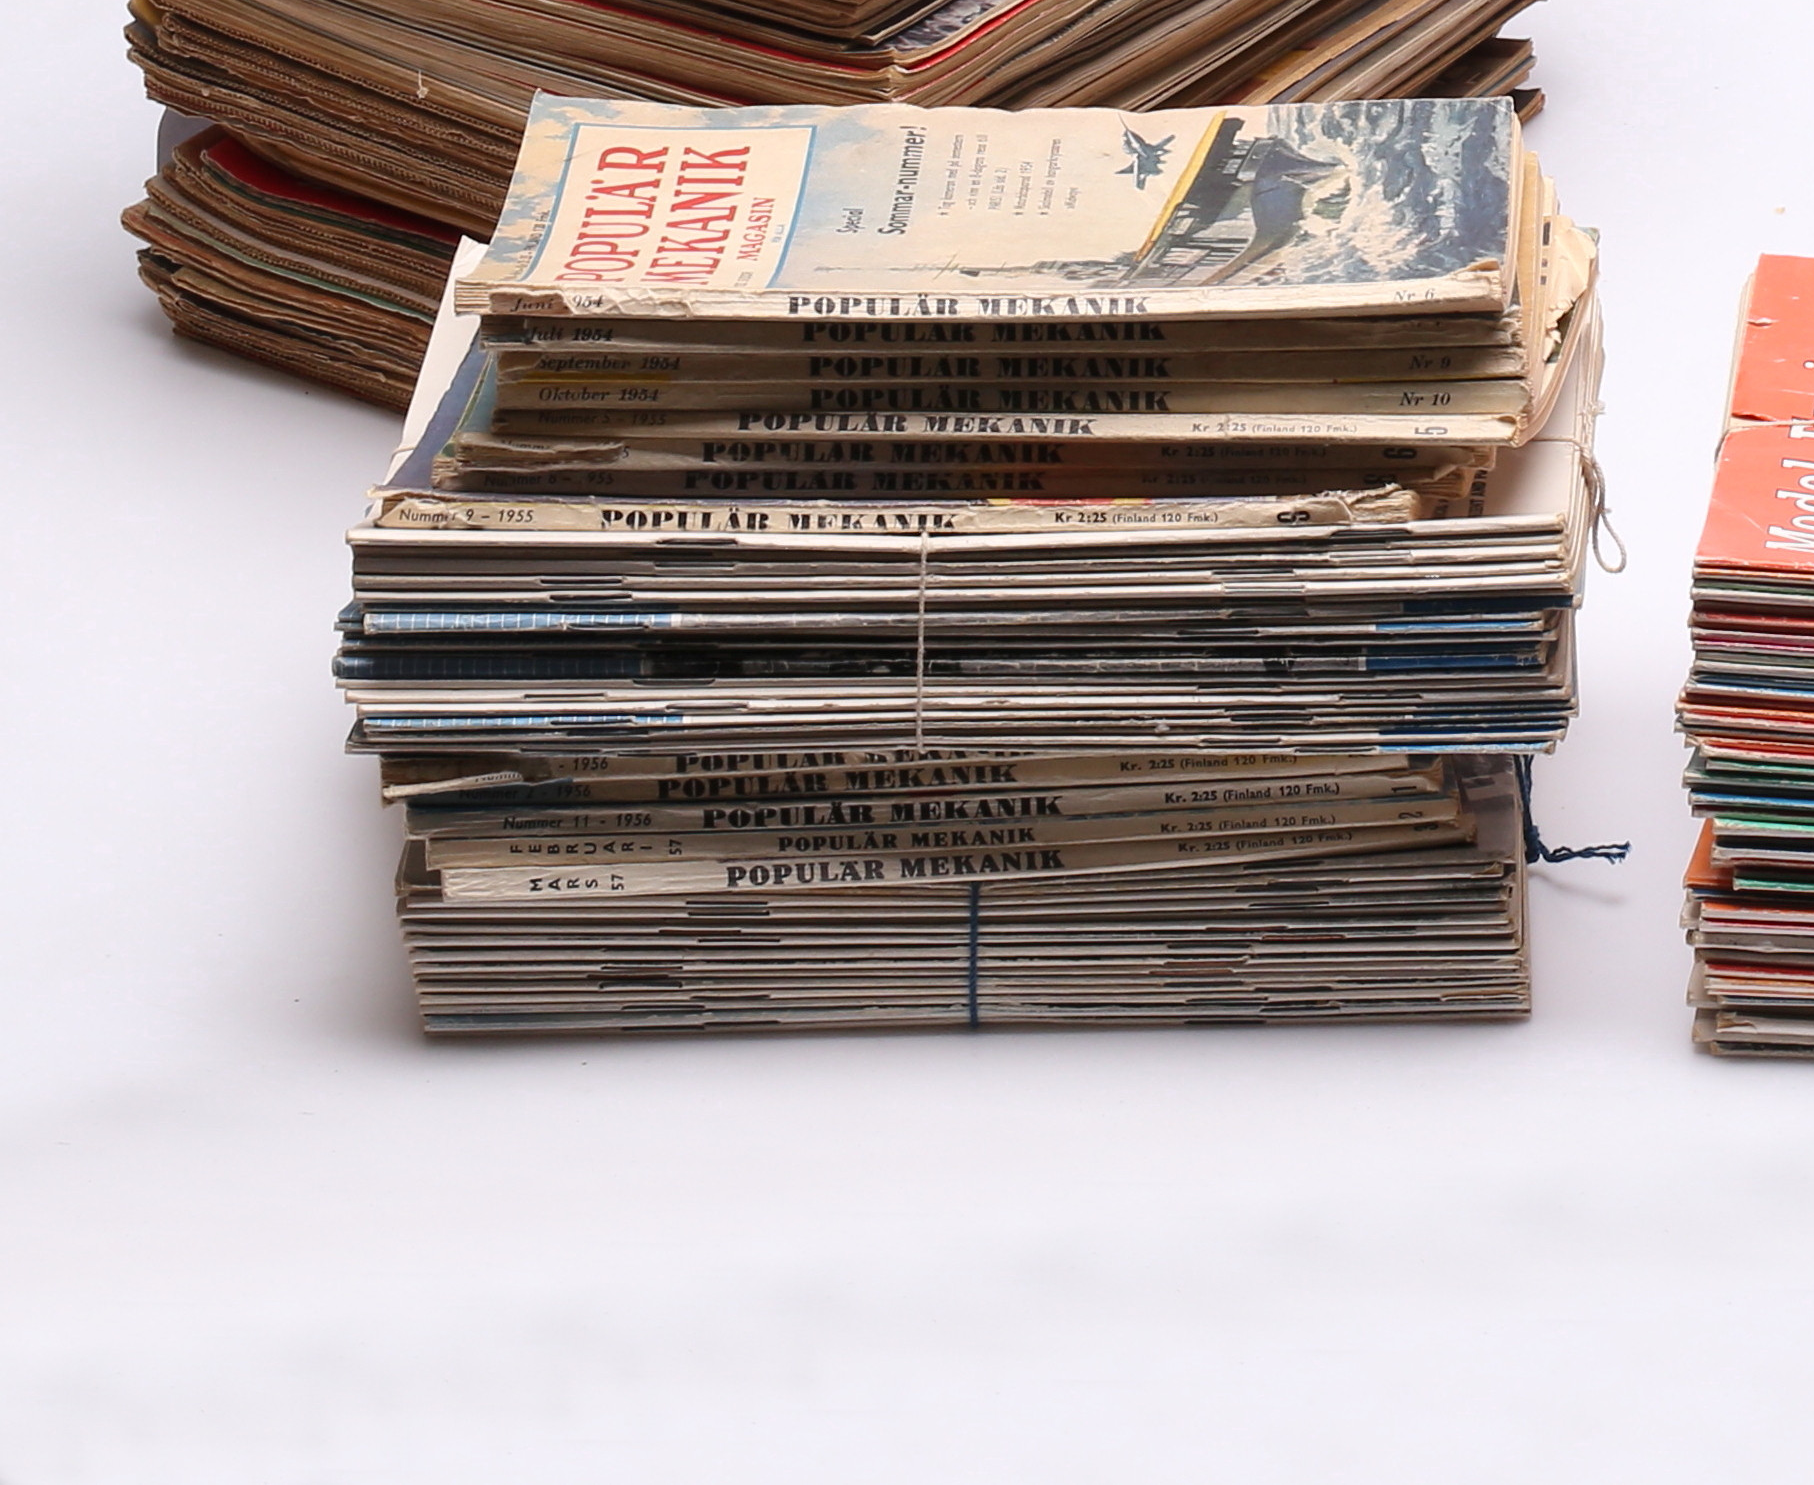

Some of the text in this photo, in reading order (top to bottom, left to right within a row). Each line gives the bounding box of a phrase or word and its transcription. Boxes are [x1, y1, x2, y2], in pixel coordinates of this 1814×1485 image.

[877, 125, 927, 235] Sommar-nummer!
[554, 146, 670, 282] POPULÄR
[640, 145, 751, 285] MEKANIK
[836, 207, 865, 233] Special
[736, 197, 776, 261] MAGASIN
[509, 297, 554, 313] Juni
[564, 294, 604, 310] 954
[788, 294, 960, 316] POPULÄR
[976, 297, 1151, 316] MEKANIK
[573, 327, 614, 343] 1954
[991, 323, 1168, 342] MEKANIK
[640, 357, 681, 370] 1954
[808, 355, 981, 378] POPULÄR
[997, 358, 1172, 378] MEKANIK
[1408, 356, 1433, 370] Nr
[538, 386, 1451, 411] Oktober 1954 POPULÄR MEKANIK Nr 10
[737, 412, 907, 433] POPULÄR
[922, 416, 1099, 436] MEKANIK
[1192, 423, 1211, 433] Kr
[1217, 423, 1247, 433] 2:25
[1252, 424, 1295, 434] (Finland
[1300, 425, 1321, 433] 120
[1326, 424, 1358, 434] Fmk.)
[889, 443, 1066, 464] MEKANIK
[872, 471, 1047, 492] MEKANIK
[466, 510, 474, 522] 9
[498, 510, 534, 523] 1955
[600, 508, 769, 531] POPULÄR
[788, 514, 958, 531] MEKANIK
[1055, 512, 1071, 523] Kr
[1077, 512, 1107, 524] 2:25
[1112, 513, 1156, 525] (Finland
[1162, 513, 1182, 523] 120
[1187, 513, 1219, 525] Fmk.)
[572, 757, 608, 771] 1956
[1120, 761, 1141, 771] Kr.
[1150, 759, 1174, 770] 2:25
[1180, 757, 1228, 770] (Finland
[1234, 755, 1255, 765] 120
[1262, 754, 1297, 765] Fmk.)
[557, 785, 592, 798] 1956
[657, 770, 828, 799] POPULÄR
[844, 765, 1018, 790] MEKANIK
[1164, 793, 1187, 804] Kr.
[1191, 790, 1217, 802] 2:25
[1223, 788, 1271, 802] (Finland
[1279, 785, 1300, 796] 120
[1306, 783, 1340, 796] Fmk.)
[503, 796, 1336, 833] Nummer 11 1956 POPULÄR MEKANIK Kr. 2:25 (Finland 120 Fmk.)
[510, 827, 1035, 855] FEBRUARI 57 POPULÄR MEKANIK
[529, 878, 599, 891] MARS
[611, 874, 624, 891] 57
[727, 859, 885, 888] POPULÄR
[900, 851, 1064, 879] MEKANIK
[1178, 842, 1200, 852] Kr.
[1204, 841, 1230, 851] 2:25
[1236, 838, 1284, 851] (Finland
[1292, 835, 1313, 845] 120
